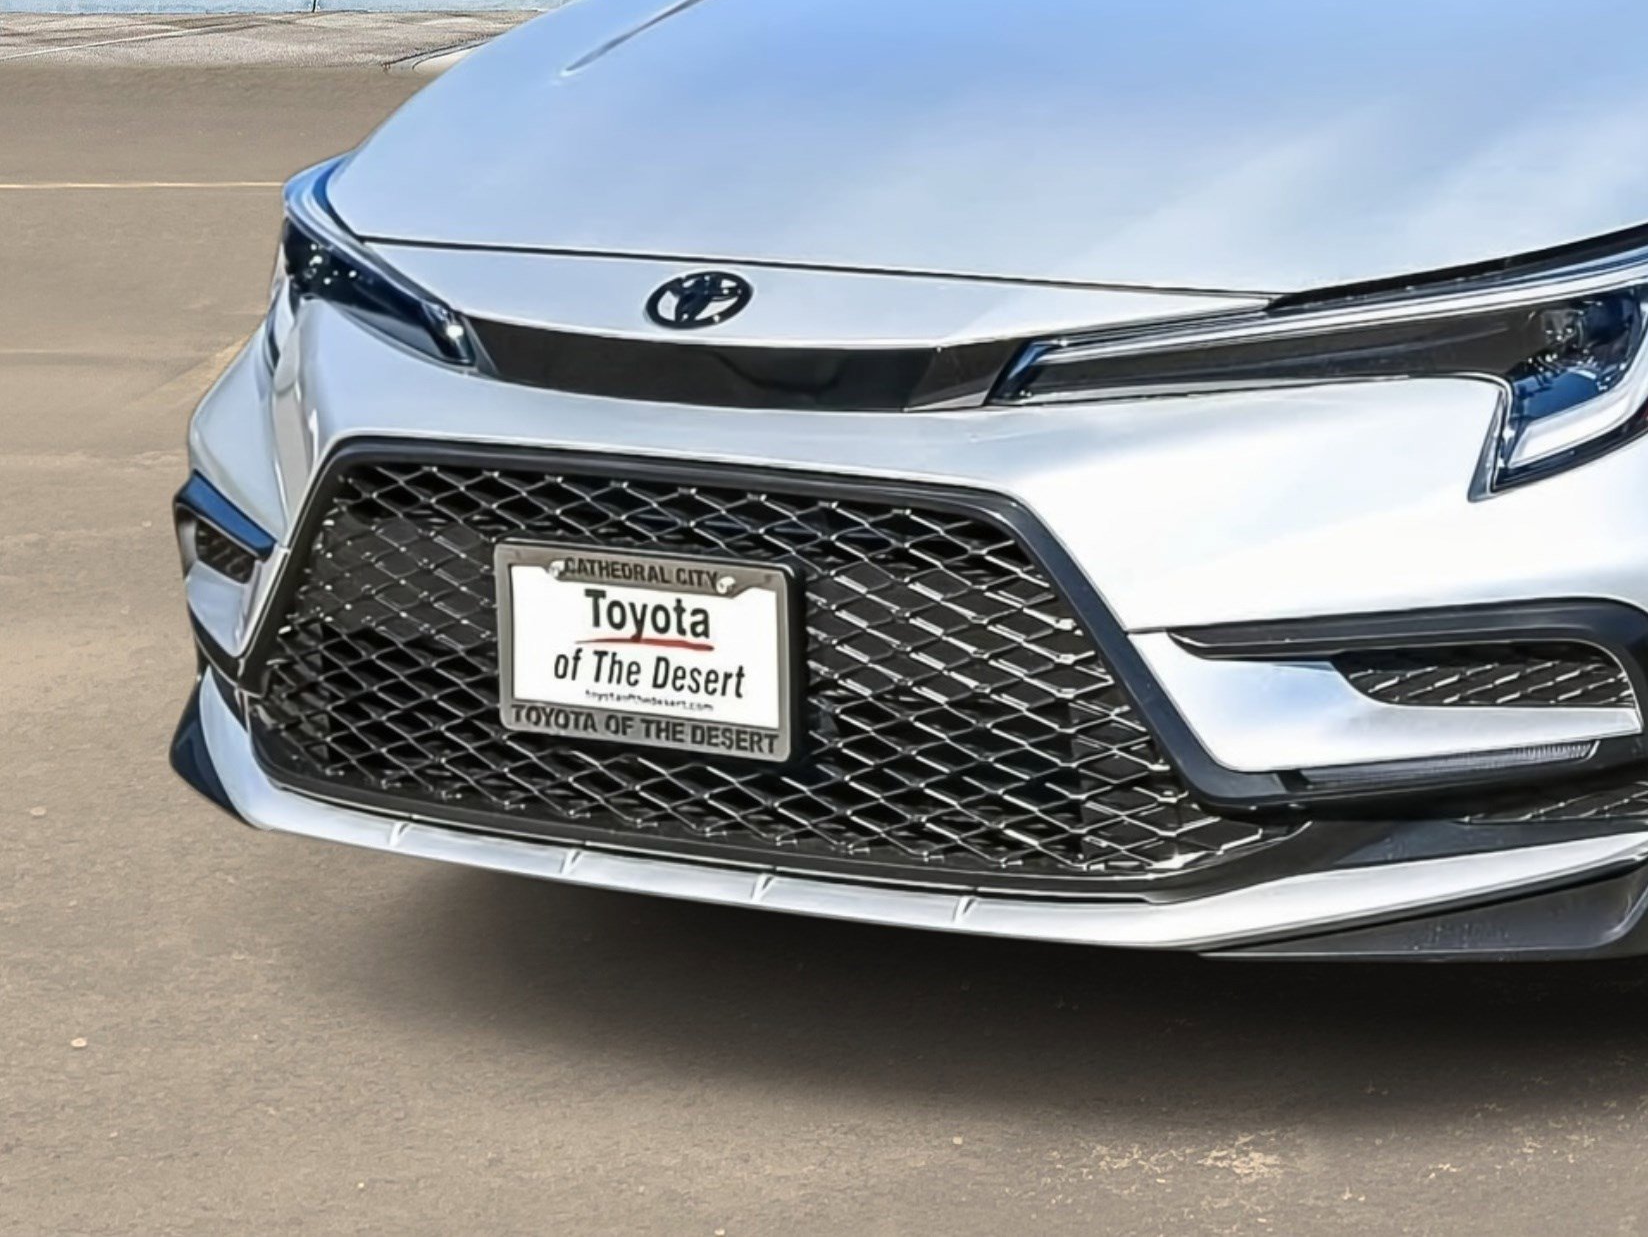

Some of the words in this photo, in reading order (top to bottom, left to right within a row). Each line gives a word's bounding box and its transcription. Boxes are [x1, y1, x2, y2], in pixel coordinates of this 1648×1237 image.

[563, 557, 672, 584] CATHEDRAL
[676, 567, 718, 591] CITY
[584, 589, 710, 641] Toyota
[554, 648, 583, 681] of
[592, 650, 641, 687] The
[652, 656, 746, 698] Desert
[511, 703, 598, 732] TOYOTA
[604, 714, 635, 736] OF
[640, 717, 685, 743] THE
[690, 724, 780, 754] DESERT
